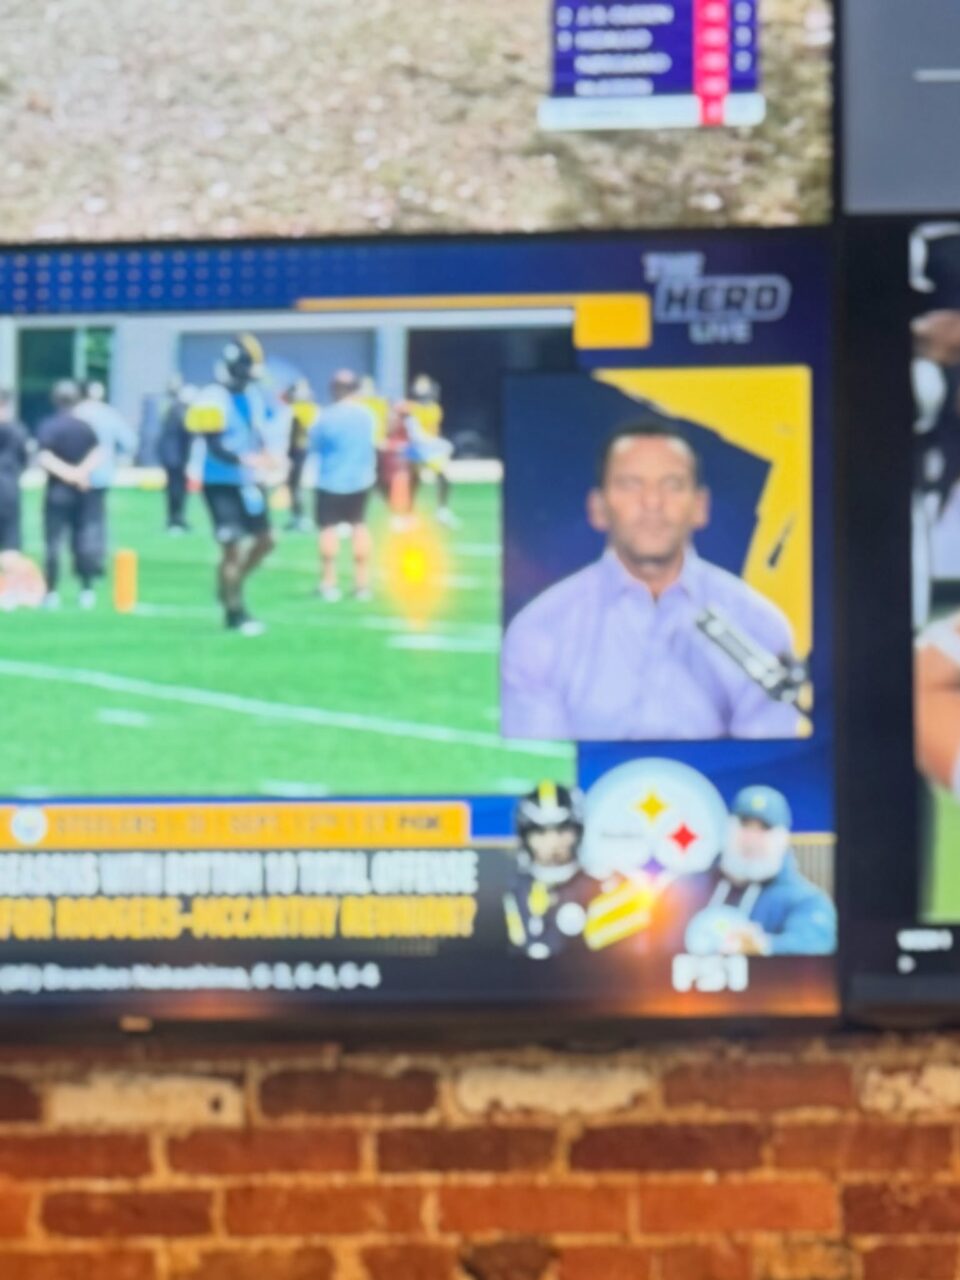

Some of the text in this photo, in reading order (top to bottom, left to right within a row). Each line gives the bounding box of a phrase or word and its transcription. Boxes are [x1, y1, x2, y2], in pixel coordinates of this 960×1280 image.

[660, 279, 785, 317] HERD
[689, 319, 752, 345] LIVE
[672, 953, 748, 988] FS1
